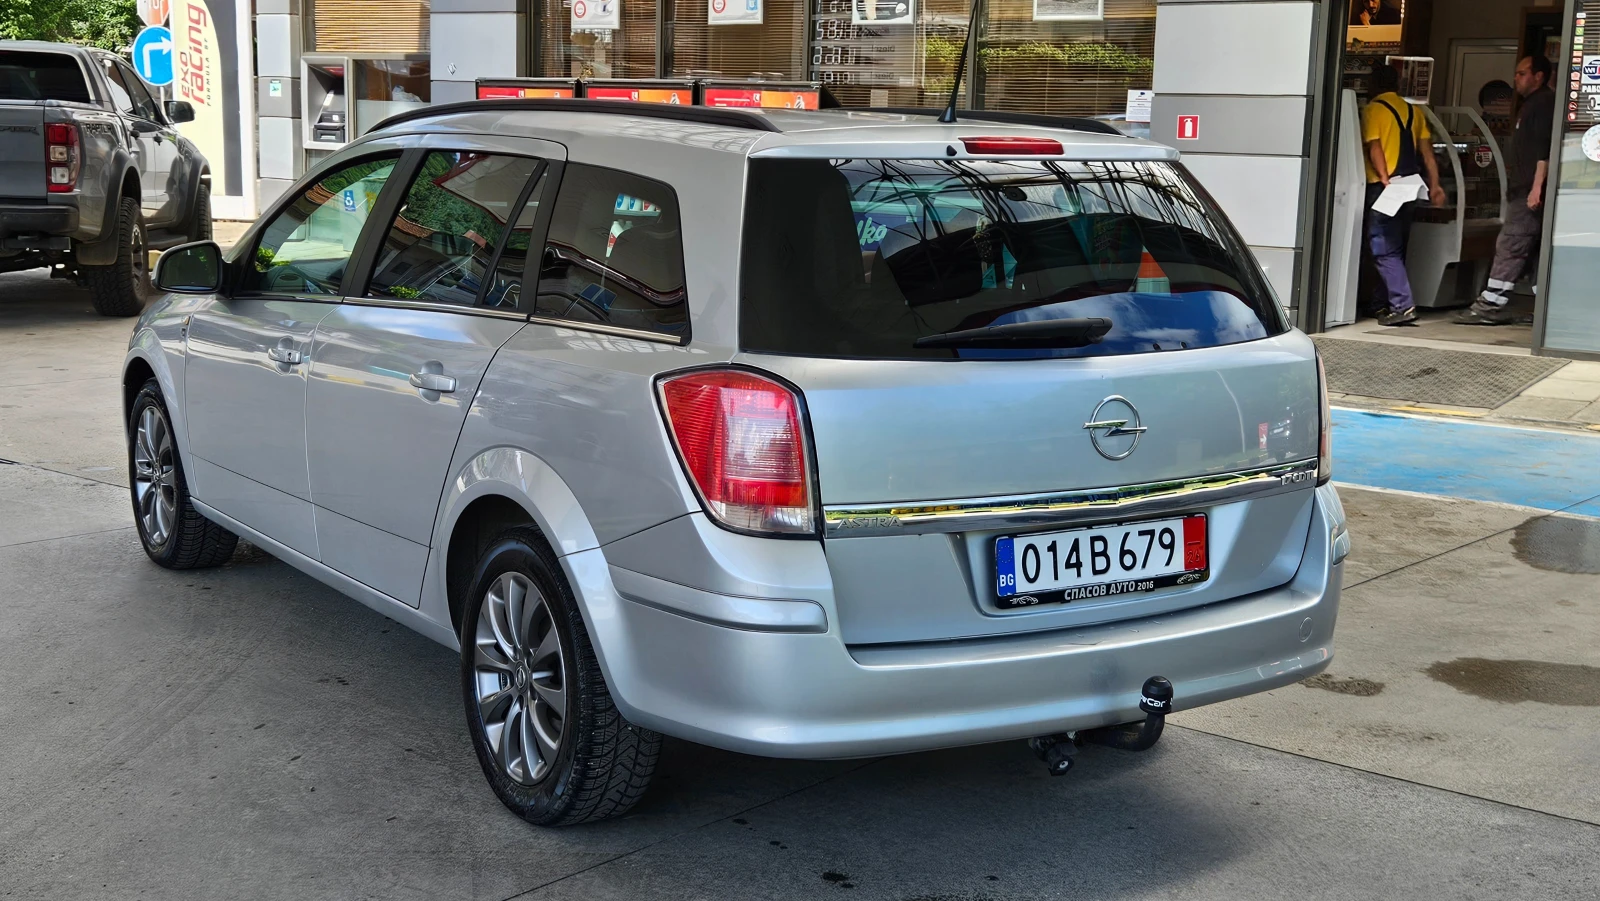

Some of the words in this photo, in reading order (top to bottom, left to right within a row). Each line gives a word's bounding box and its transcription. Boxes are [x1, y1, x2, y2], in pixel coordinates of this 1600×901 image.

[187, 3, 207, 105] racing
[837, 516, 903, 529] ASTRA
[999, 573, 1014, 587] BG
[1064, 583, 1107, 601] СПАСОВ
[1109, 580, 1136, 595] АУТО
[1137, 580, 1154, 591] 2016
